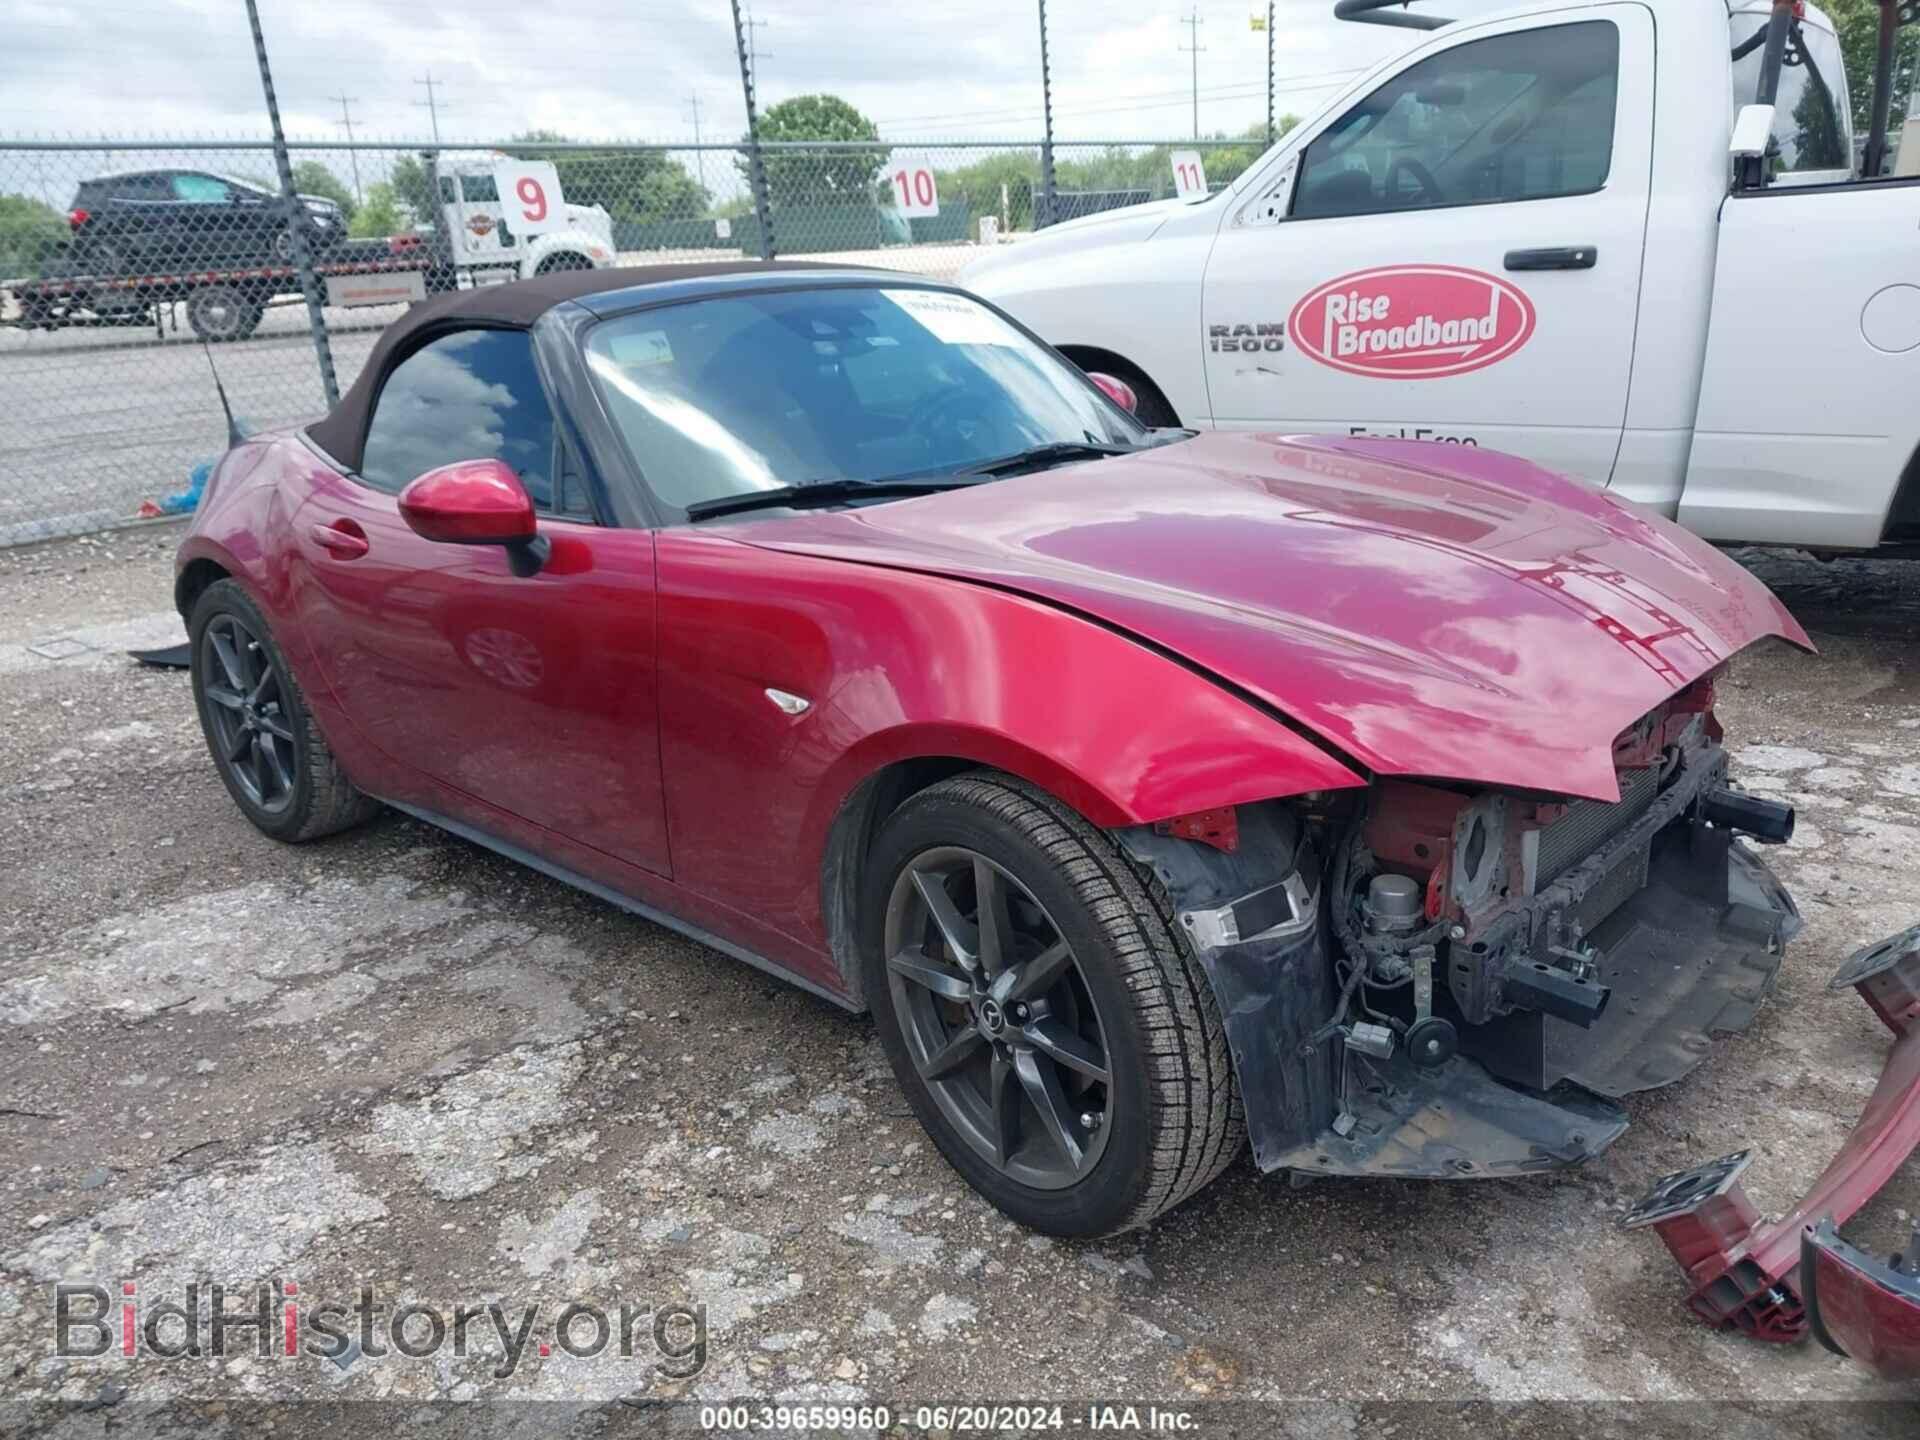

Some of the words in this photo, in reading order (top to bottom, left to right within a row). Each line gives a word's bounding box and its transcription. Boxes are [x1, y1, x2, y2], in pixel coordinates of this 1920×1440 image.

[896, 169, 933, 207] 10
[1178, 163, 1201, 190] 11
[516, 177, 547, 221] 9
[1209, 322, 1285, 337] RAM
[1337, 284, 1501, 357] Broadband
[1209, 338, 1285, 352] 1500
